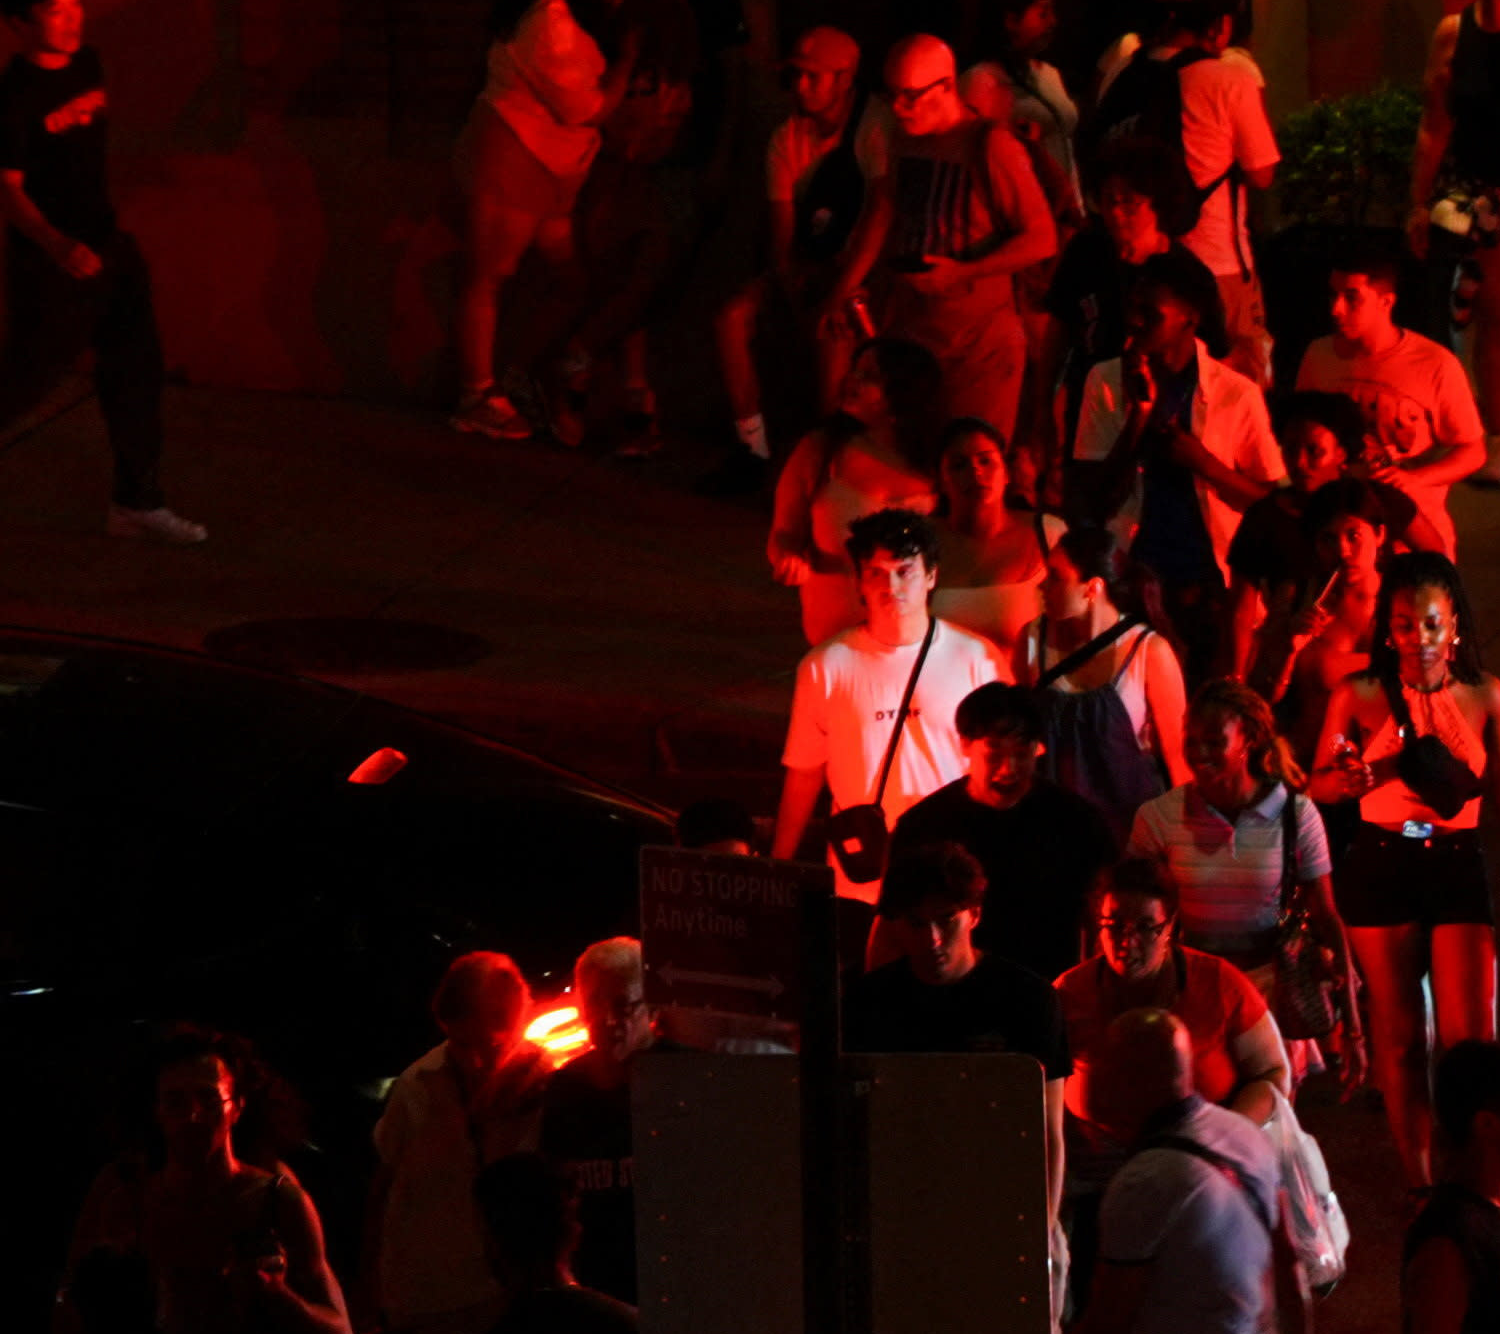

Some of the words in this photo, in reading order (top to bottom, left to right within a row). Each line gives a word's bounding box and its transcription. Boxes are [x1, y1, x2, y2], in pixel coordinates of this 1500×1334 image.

[652, 866, 685, 894] NO
[690, 869, 800, 908] STOPPING
[656, 900, 750, 939] Anytime
